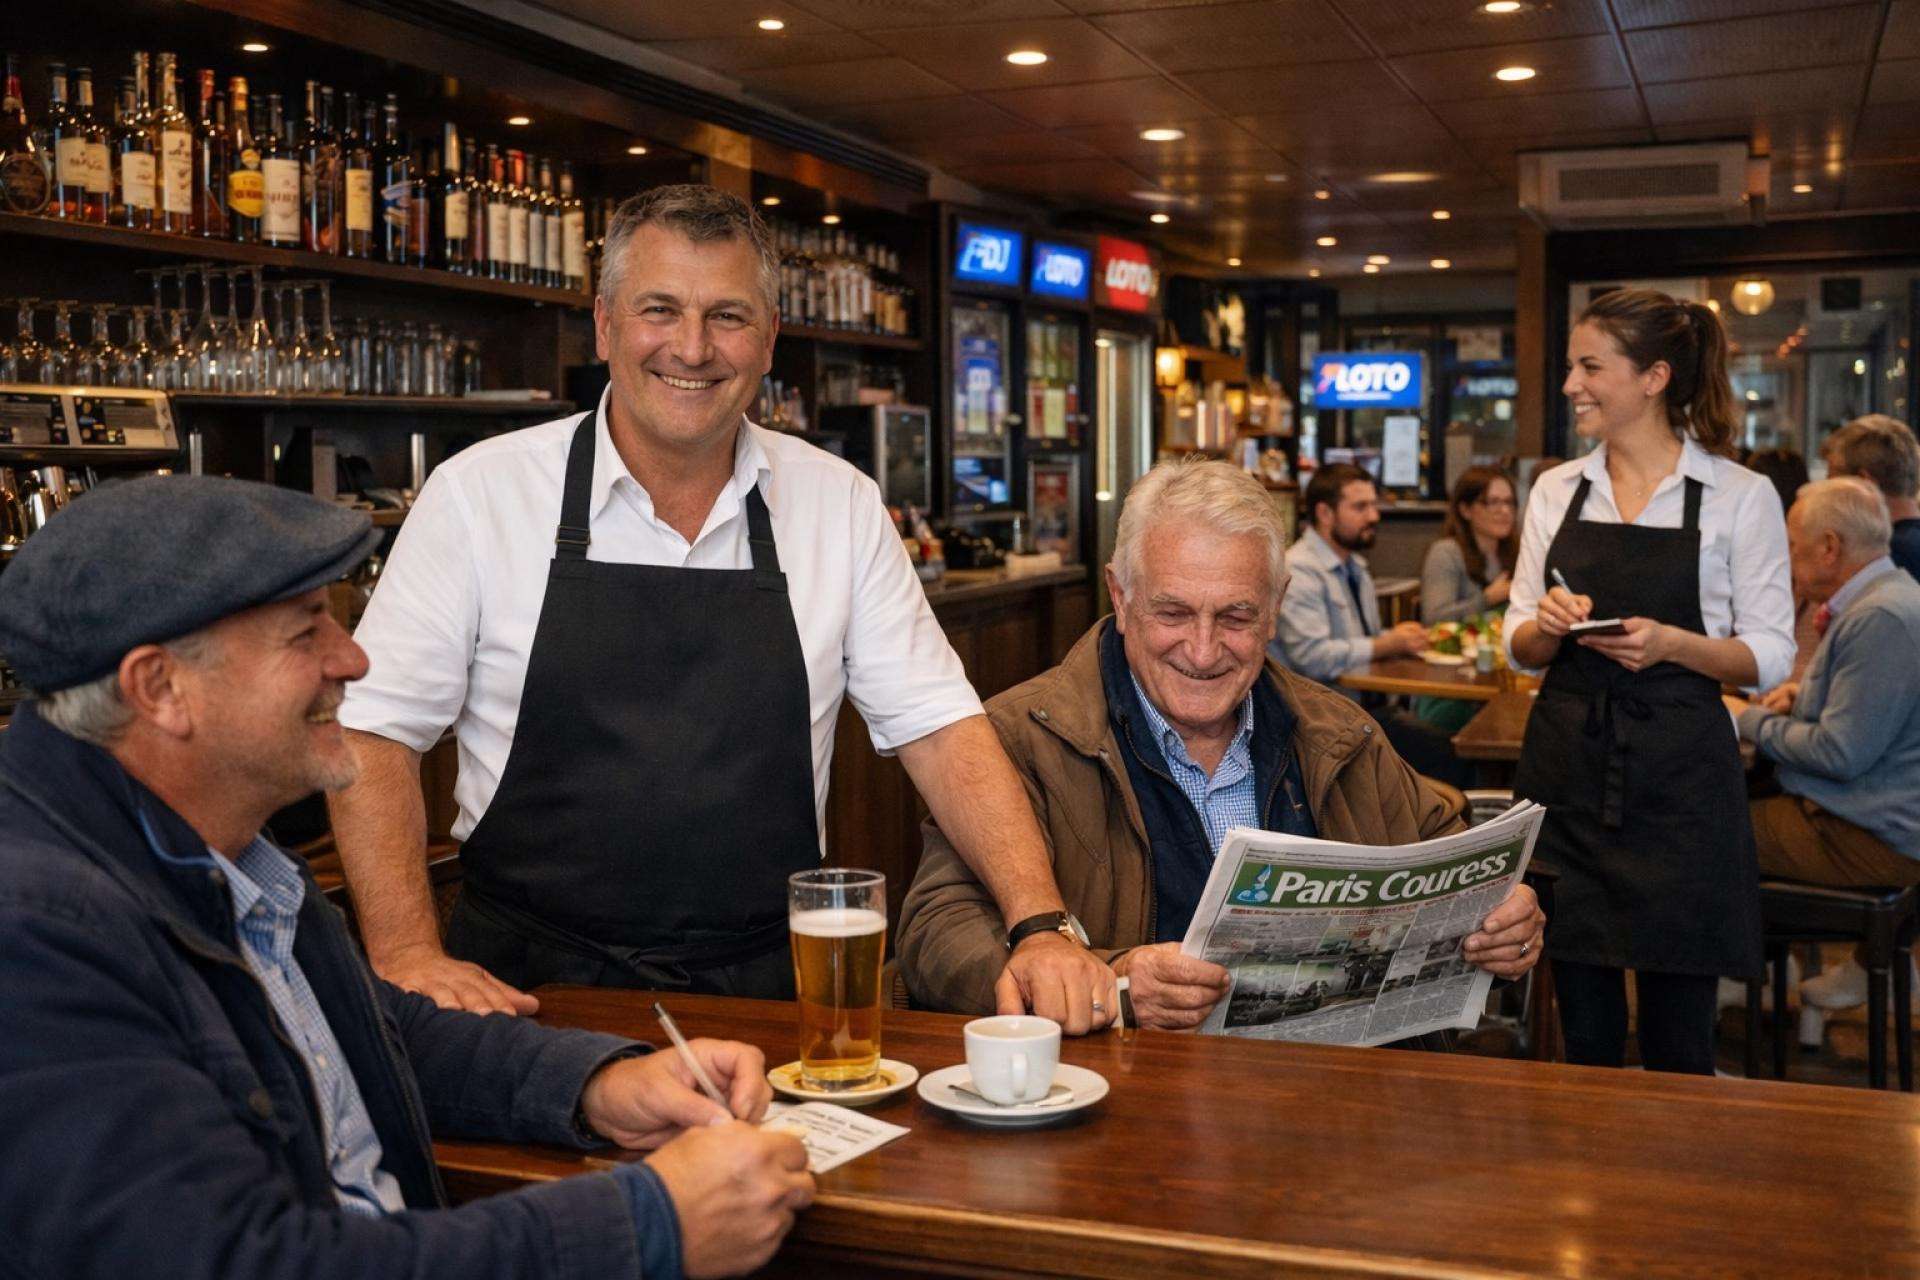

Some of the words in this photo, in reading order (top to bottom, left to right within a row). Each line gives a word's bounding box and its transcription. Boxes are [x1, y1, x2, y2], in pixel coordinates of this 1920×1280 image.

[1106, 257, 1154, 295] LOTO
[1335, 361, 1411, 392] LOTO
[1270, 871, 1373, 904] Paris
[1378, 851, 1511, 901] Couress
